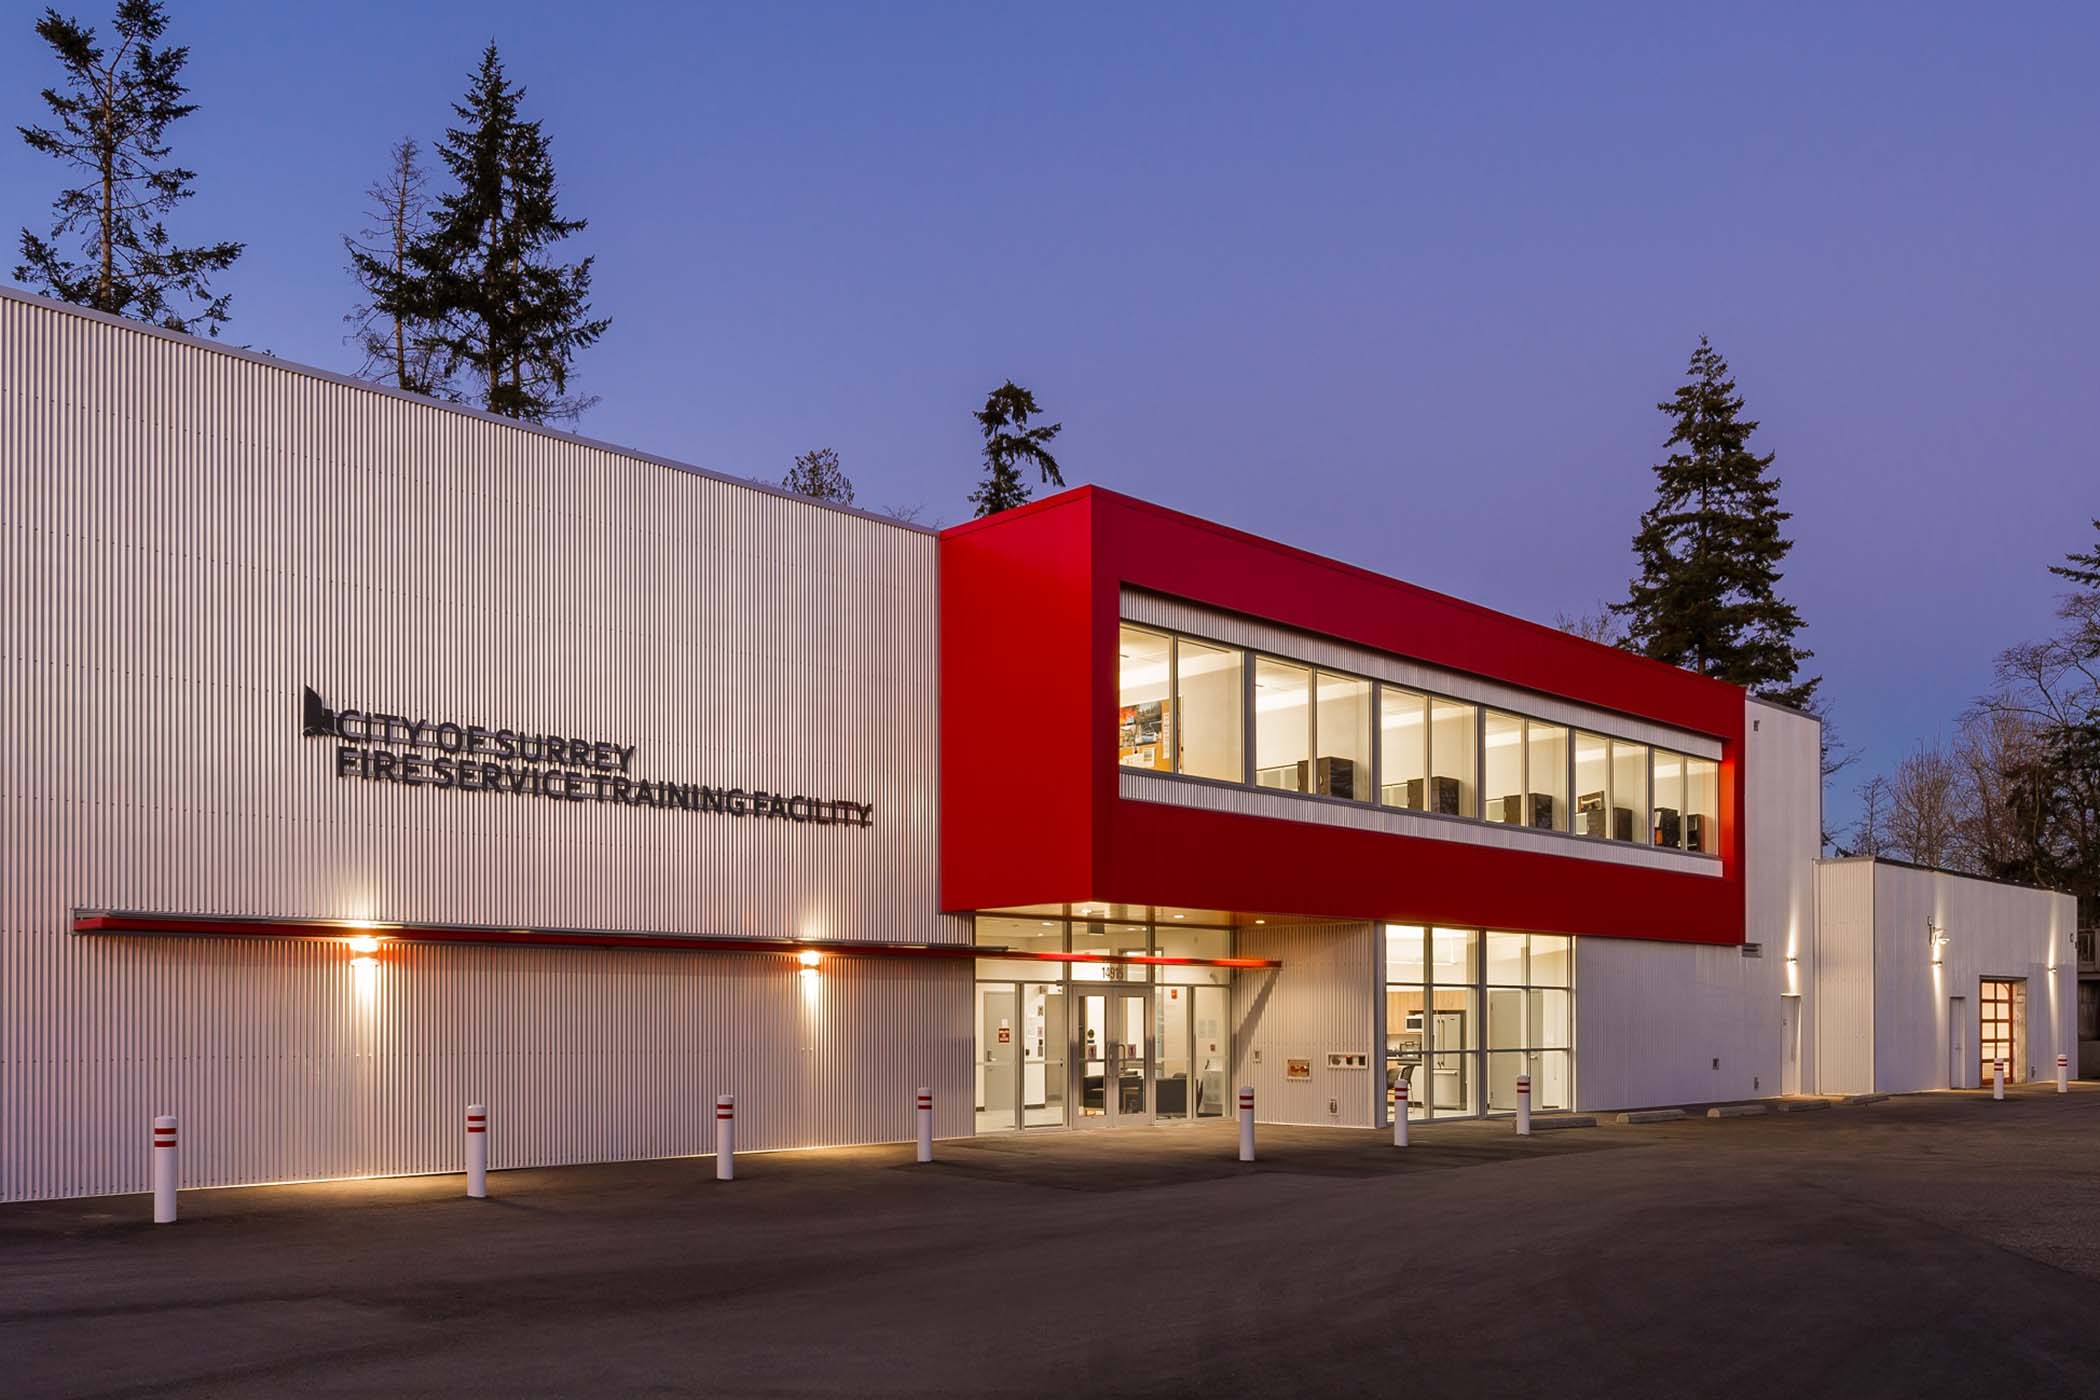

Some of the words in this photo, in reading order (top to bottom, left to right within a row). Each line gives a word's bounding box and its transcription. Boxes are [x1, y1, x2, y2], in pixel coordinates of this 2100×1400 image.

[338, 709, 426, 748] CITY
[437, 721, 487, 756] OF
[496, 729, 636, 772] SURREY
[337, 745, 422, 787] FIRE
[433, 757, 584, 803] SERVICE
[590, 773, 744, 817] TRAINING
[754, 790, 872, 828] FACILITY
